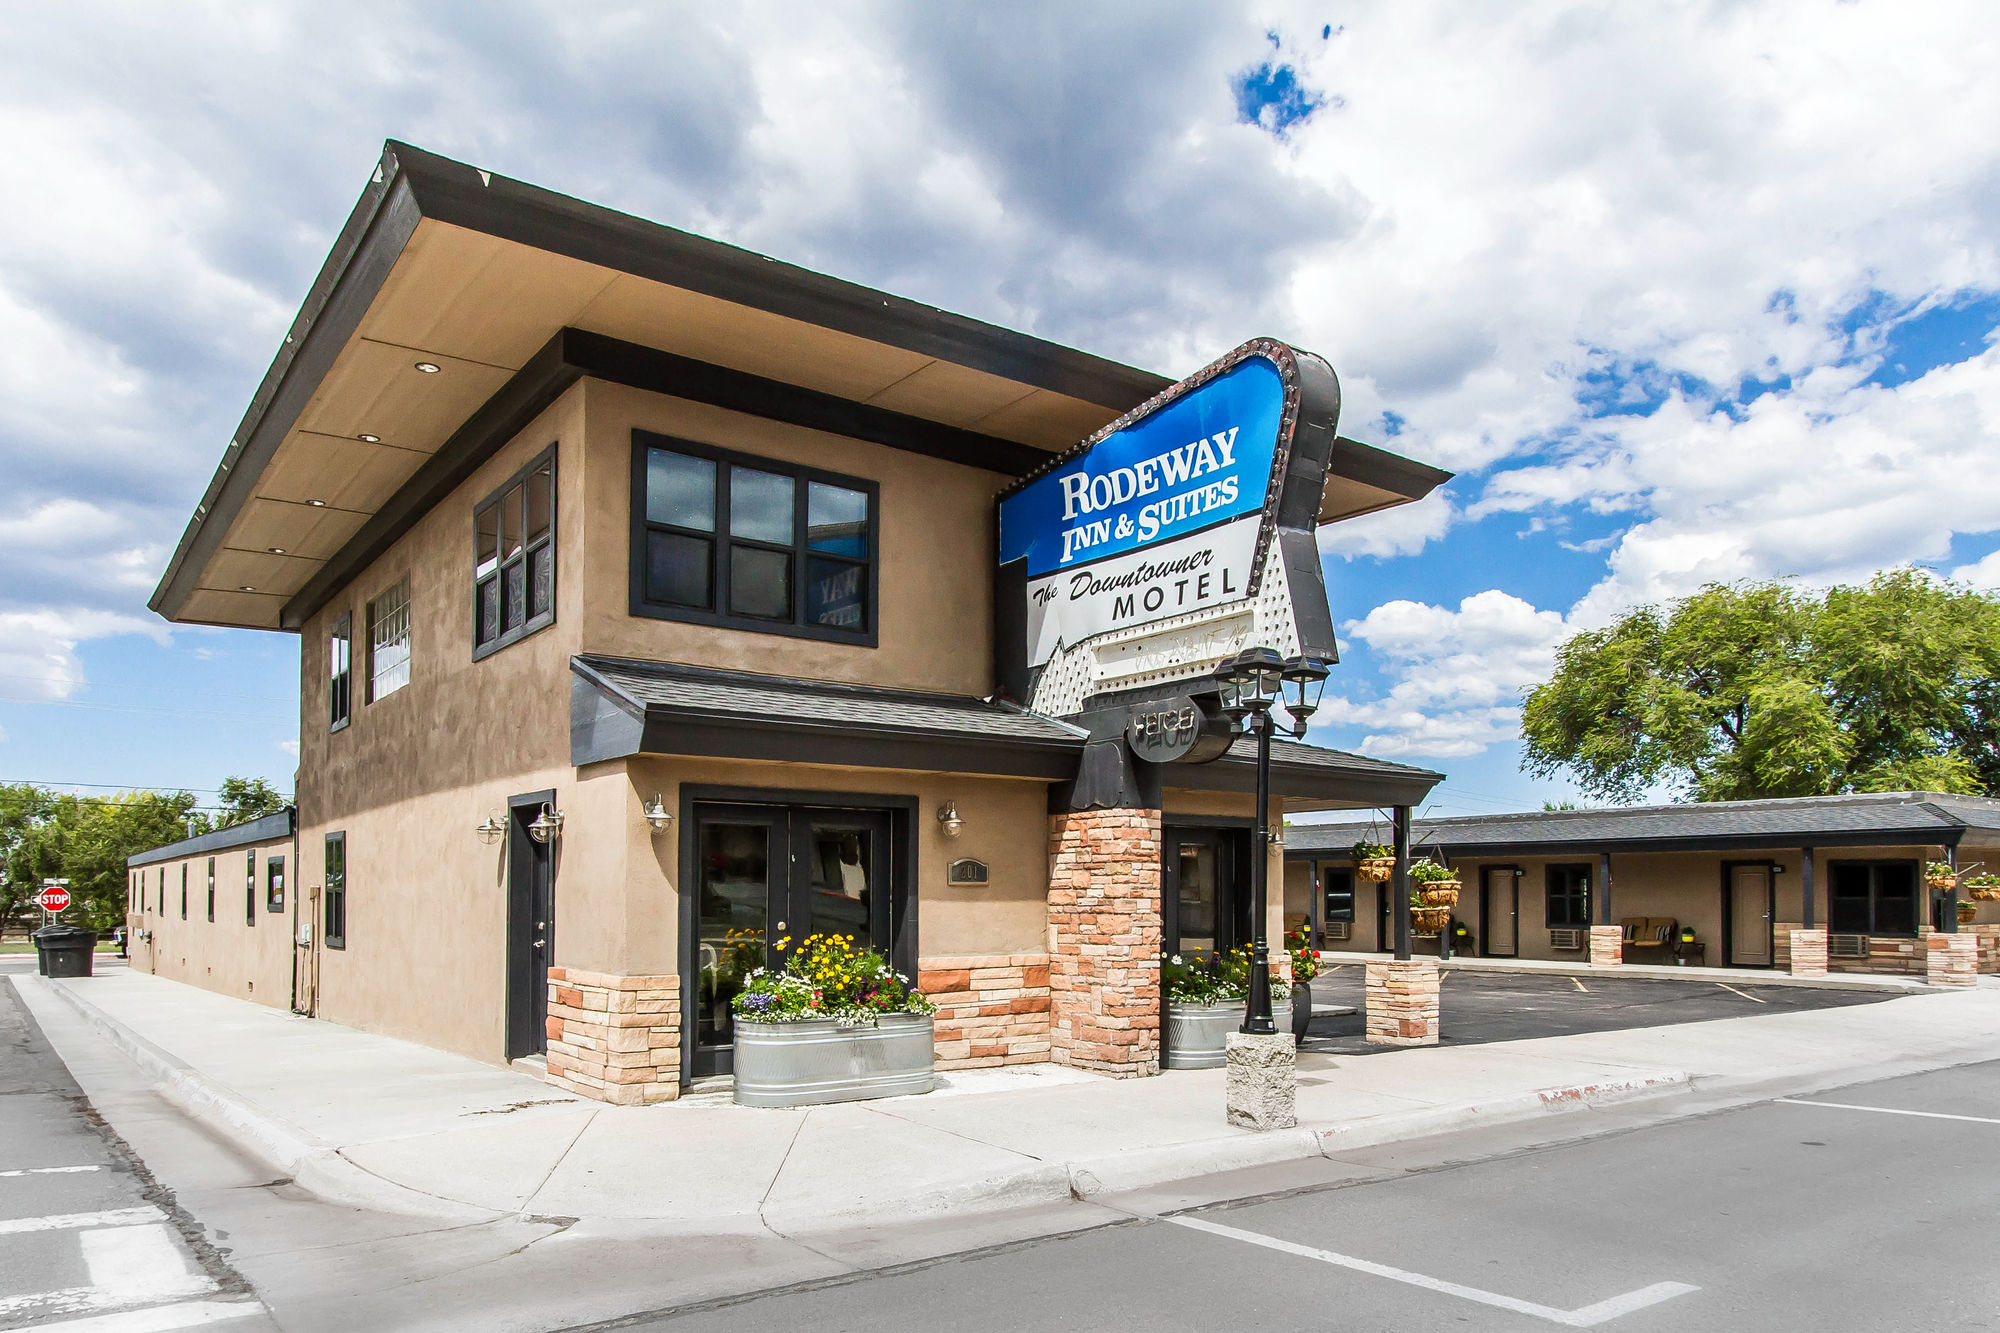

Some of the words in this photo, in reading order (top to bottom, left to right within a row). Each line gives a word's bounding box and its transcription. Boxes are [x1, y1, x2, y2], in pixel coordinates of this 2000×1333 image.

[1059, 426, 1239, 521] RODEWAY
[1059, 518, 1112, 563] INN
[1114, 513, 1135, 539] &
[1137, 475, 1239, 542] SUITES
[1033, 584, 1058, 607] The
[1069, 548, 1215, 601] Downtowner
[1112, 568, 1236, 621] MOTEL
[42, 894, 68, 905] STOP
